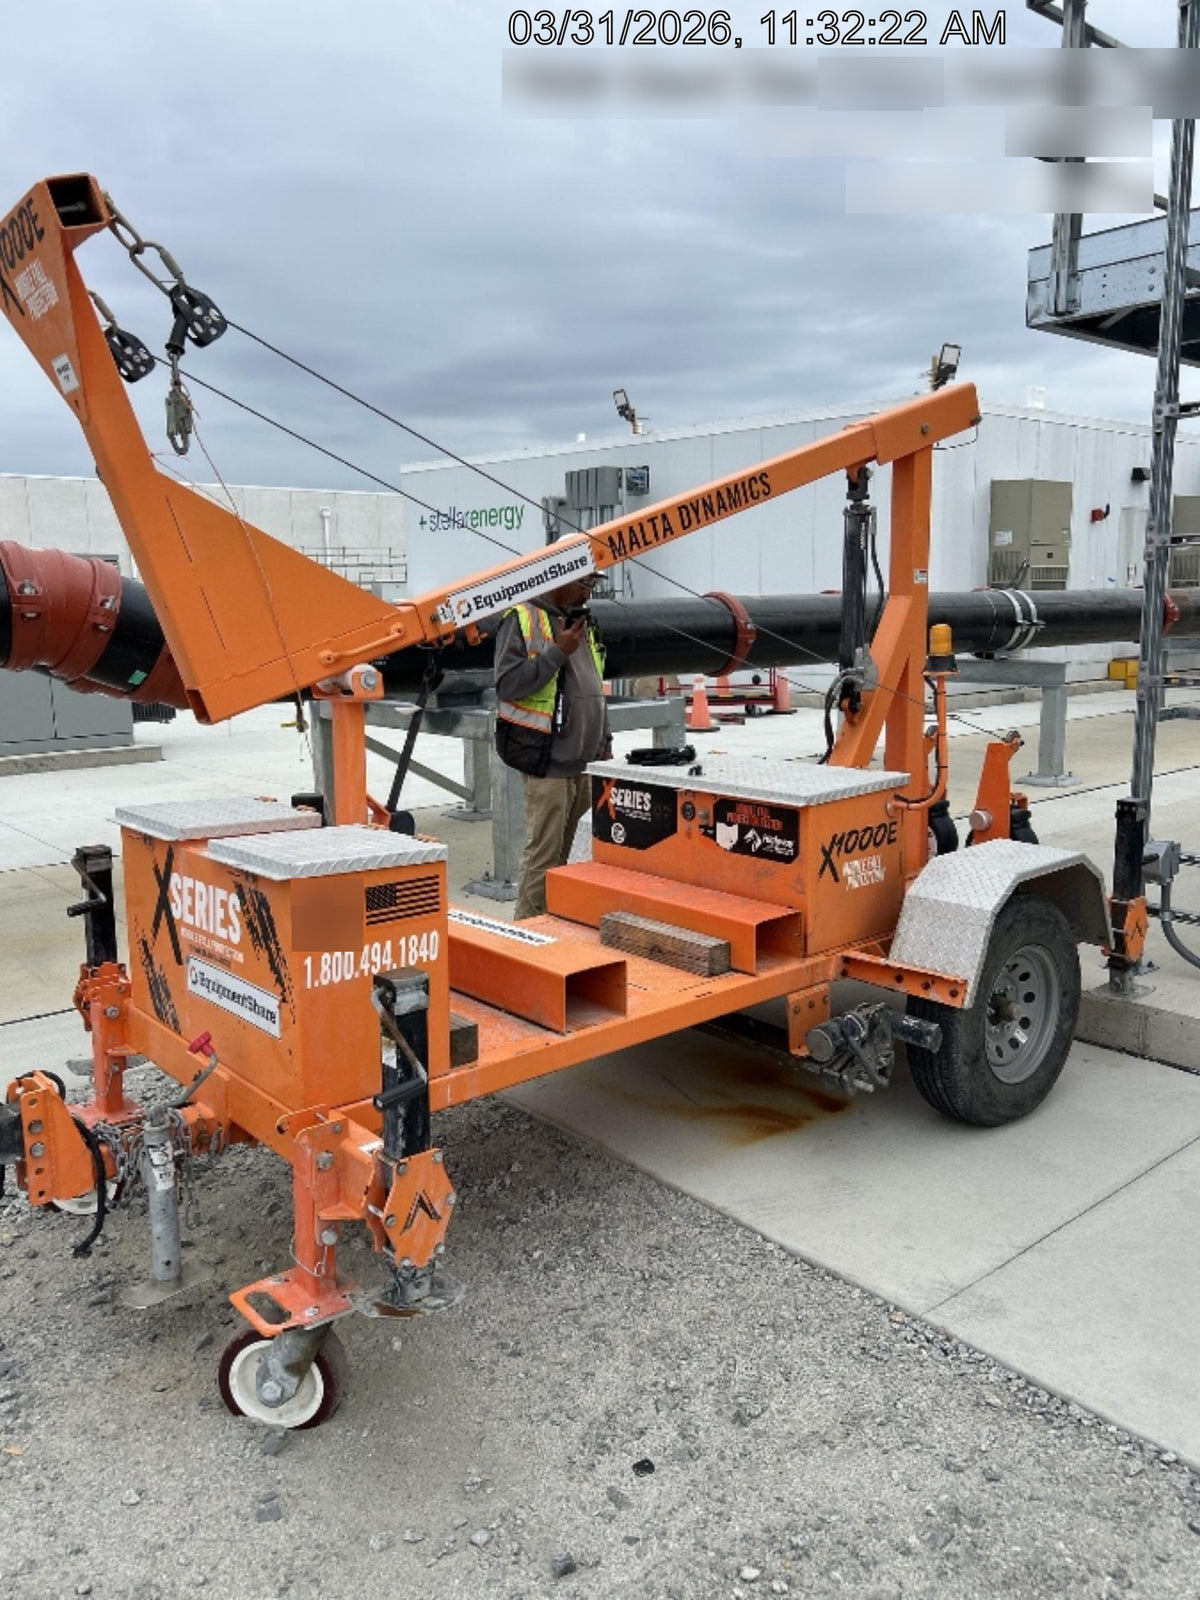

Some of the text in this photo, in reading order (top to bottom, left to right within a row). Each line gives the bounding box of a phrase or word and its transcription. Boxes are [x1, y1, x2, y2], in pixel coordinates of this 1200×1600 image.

[608, 472, 772, 560] MALTA DYNAMICS
[473, 555, 588, 610] EquipmentShare
[610, 787, 652, 812] SERIES
[169, 872, 242, 945] SERIES
[304, 929, 440, 990] 1.800.494.1840
[198, 970, 278, 1025] EquipmentShare
